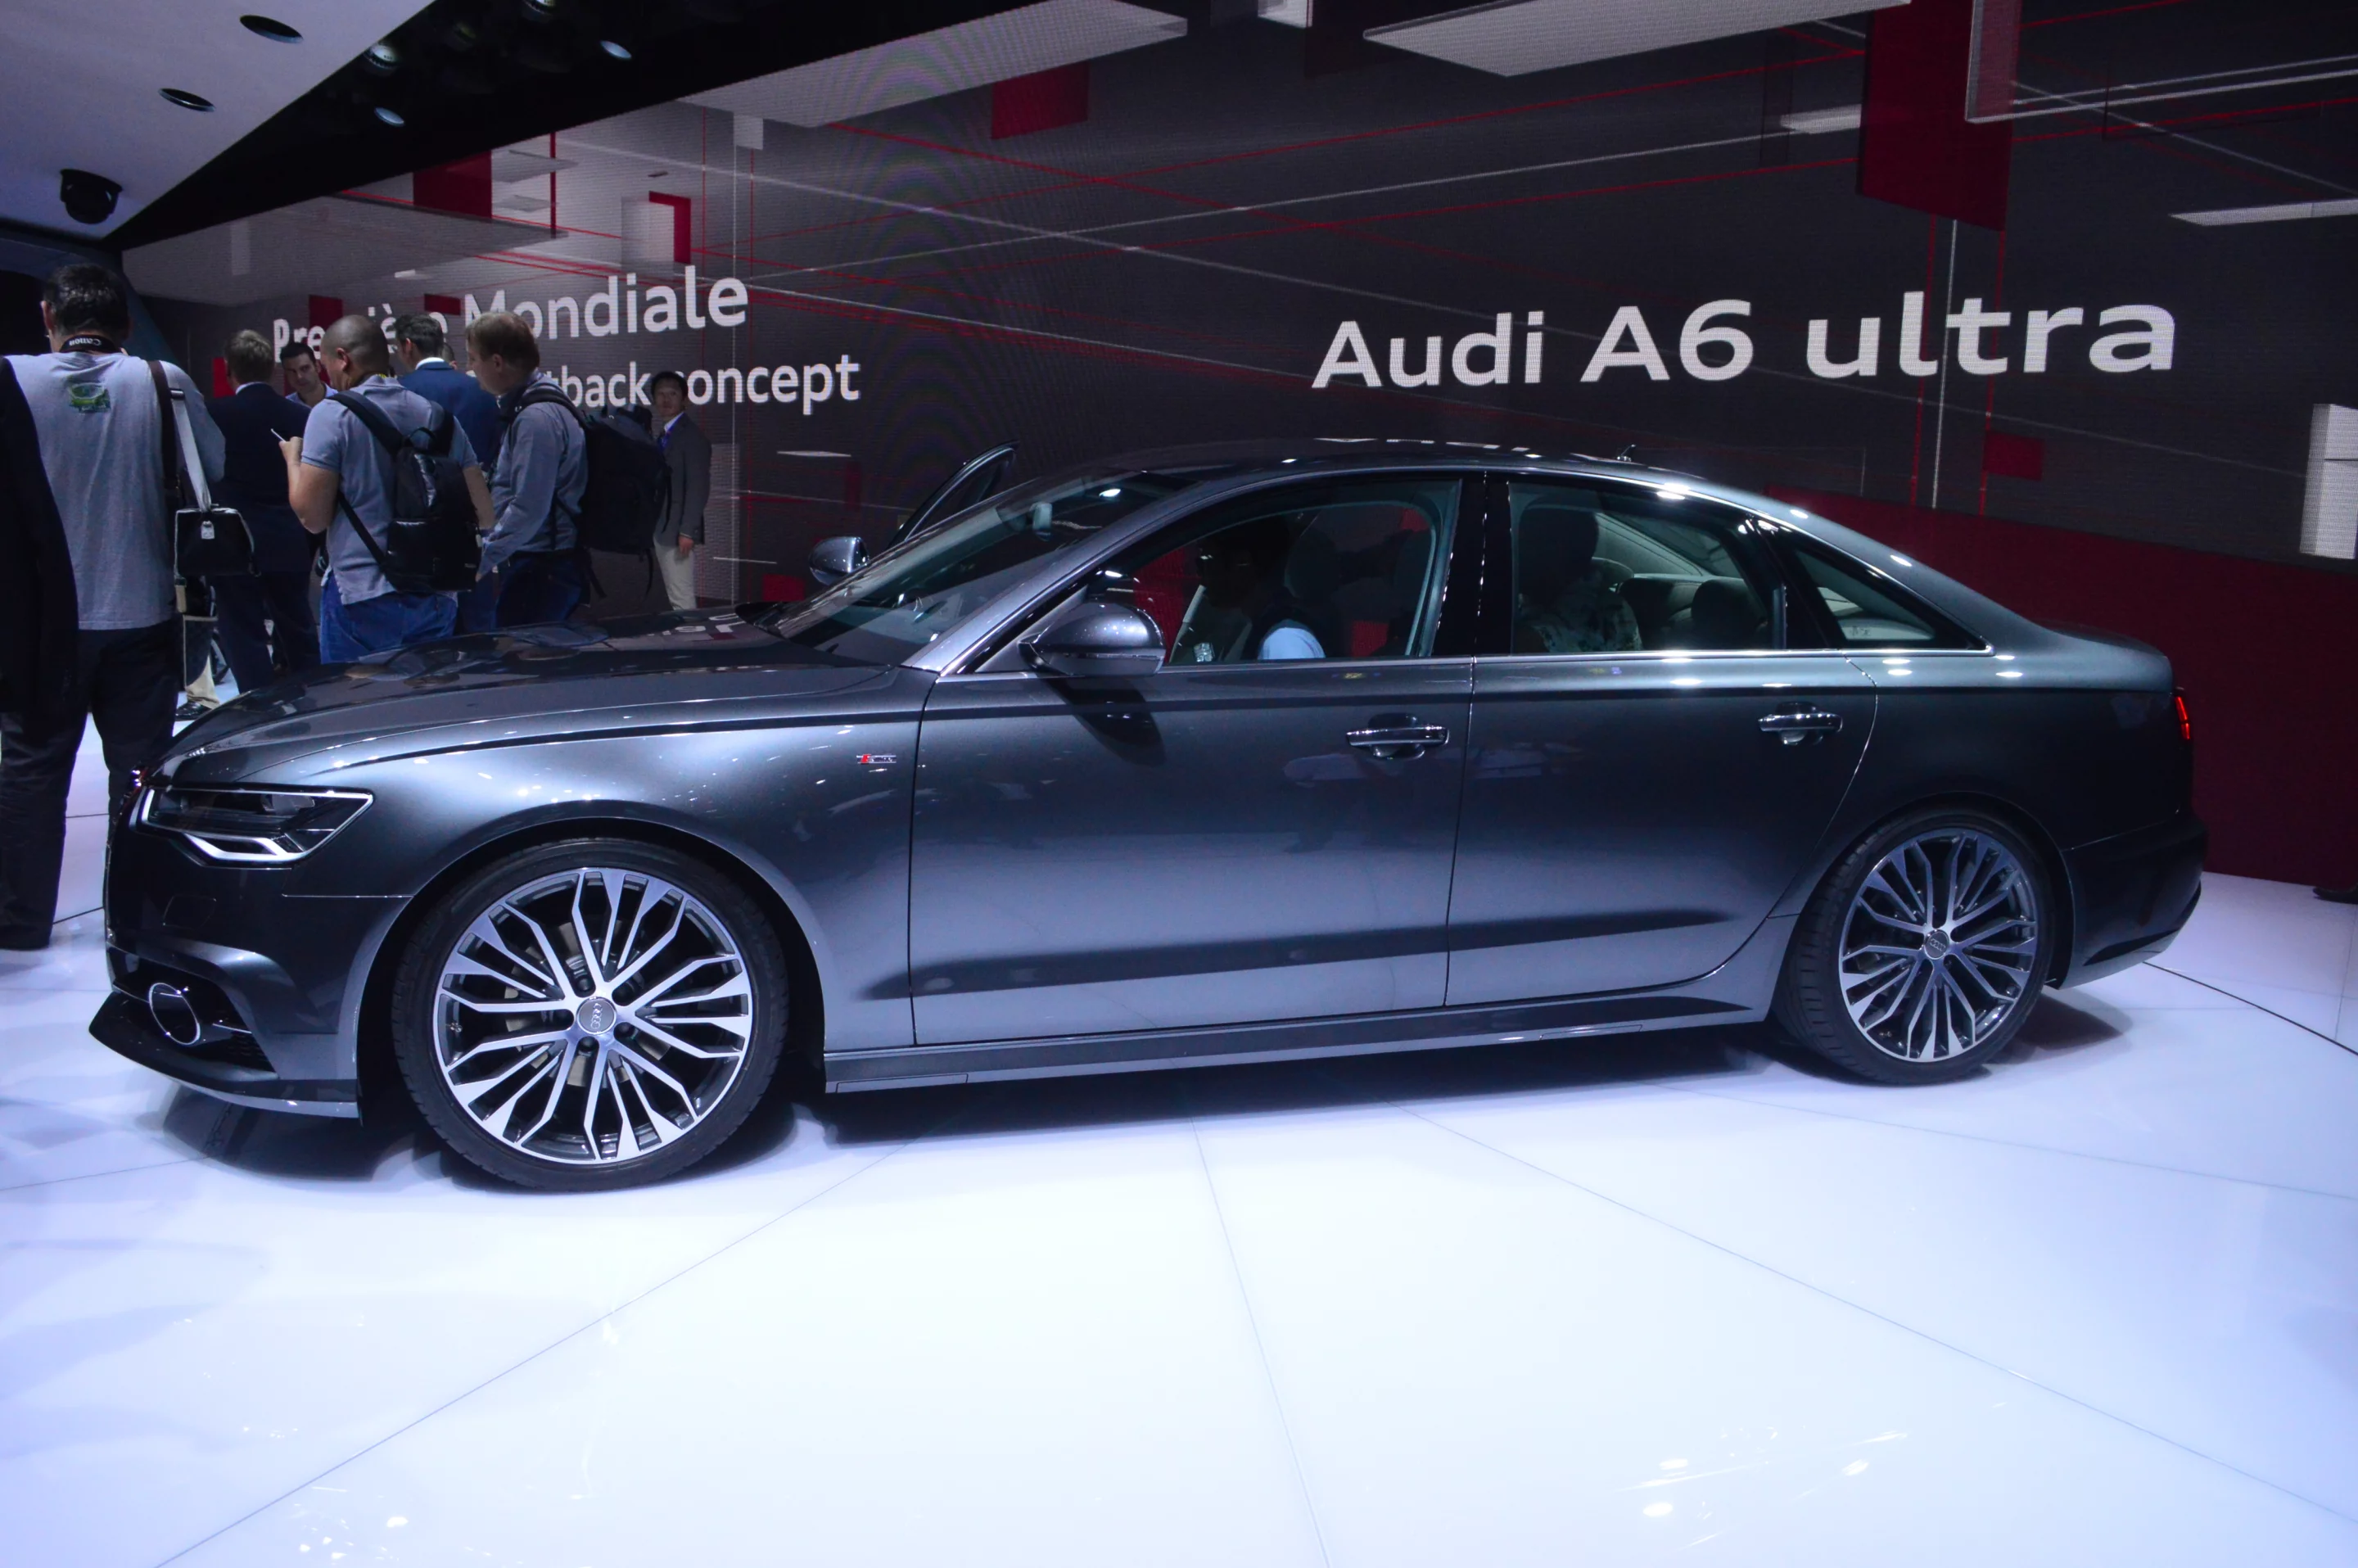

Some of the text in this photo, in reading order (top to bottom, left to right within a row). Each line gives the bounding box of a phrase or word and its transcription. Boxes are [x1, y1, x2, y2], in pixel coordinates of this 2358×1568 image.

[69, 337, 102, 346] Canon
[1312, 291, 2175, 388] Audi A6 ultra
[675, 354, 860, 415] oncept
